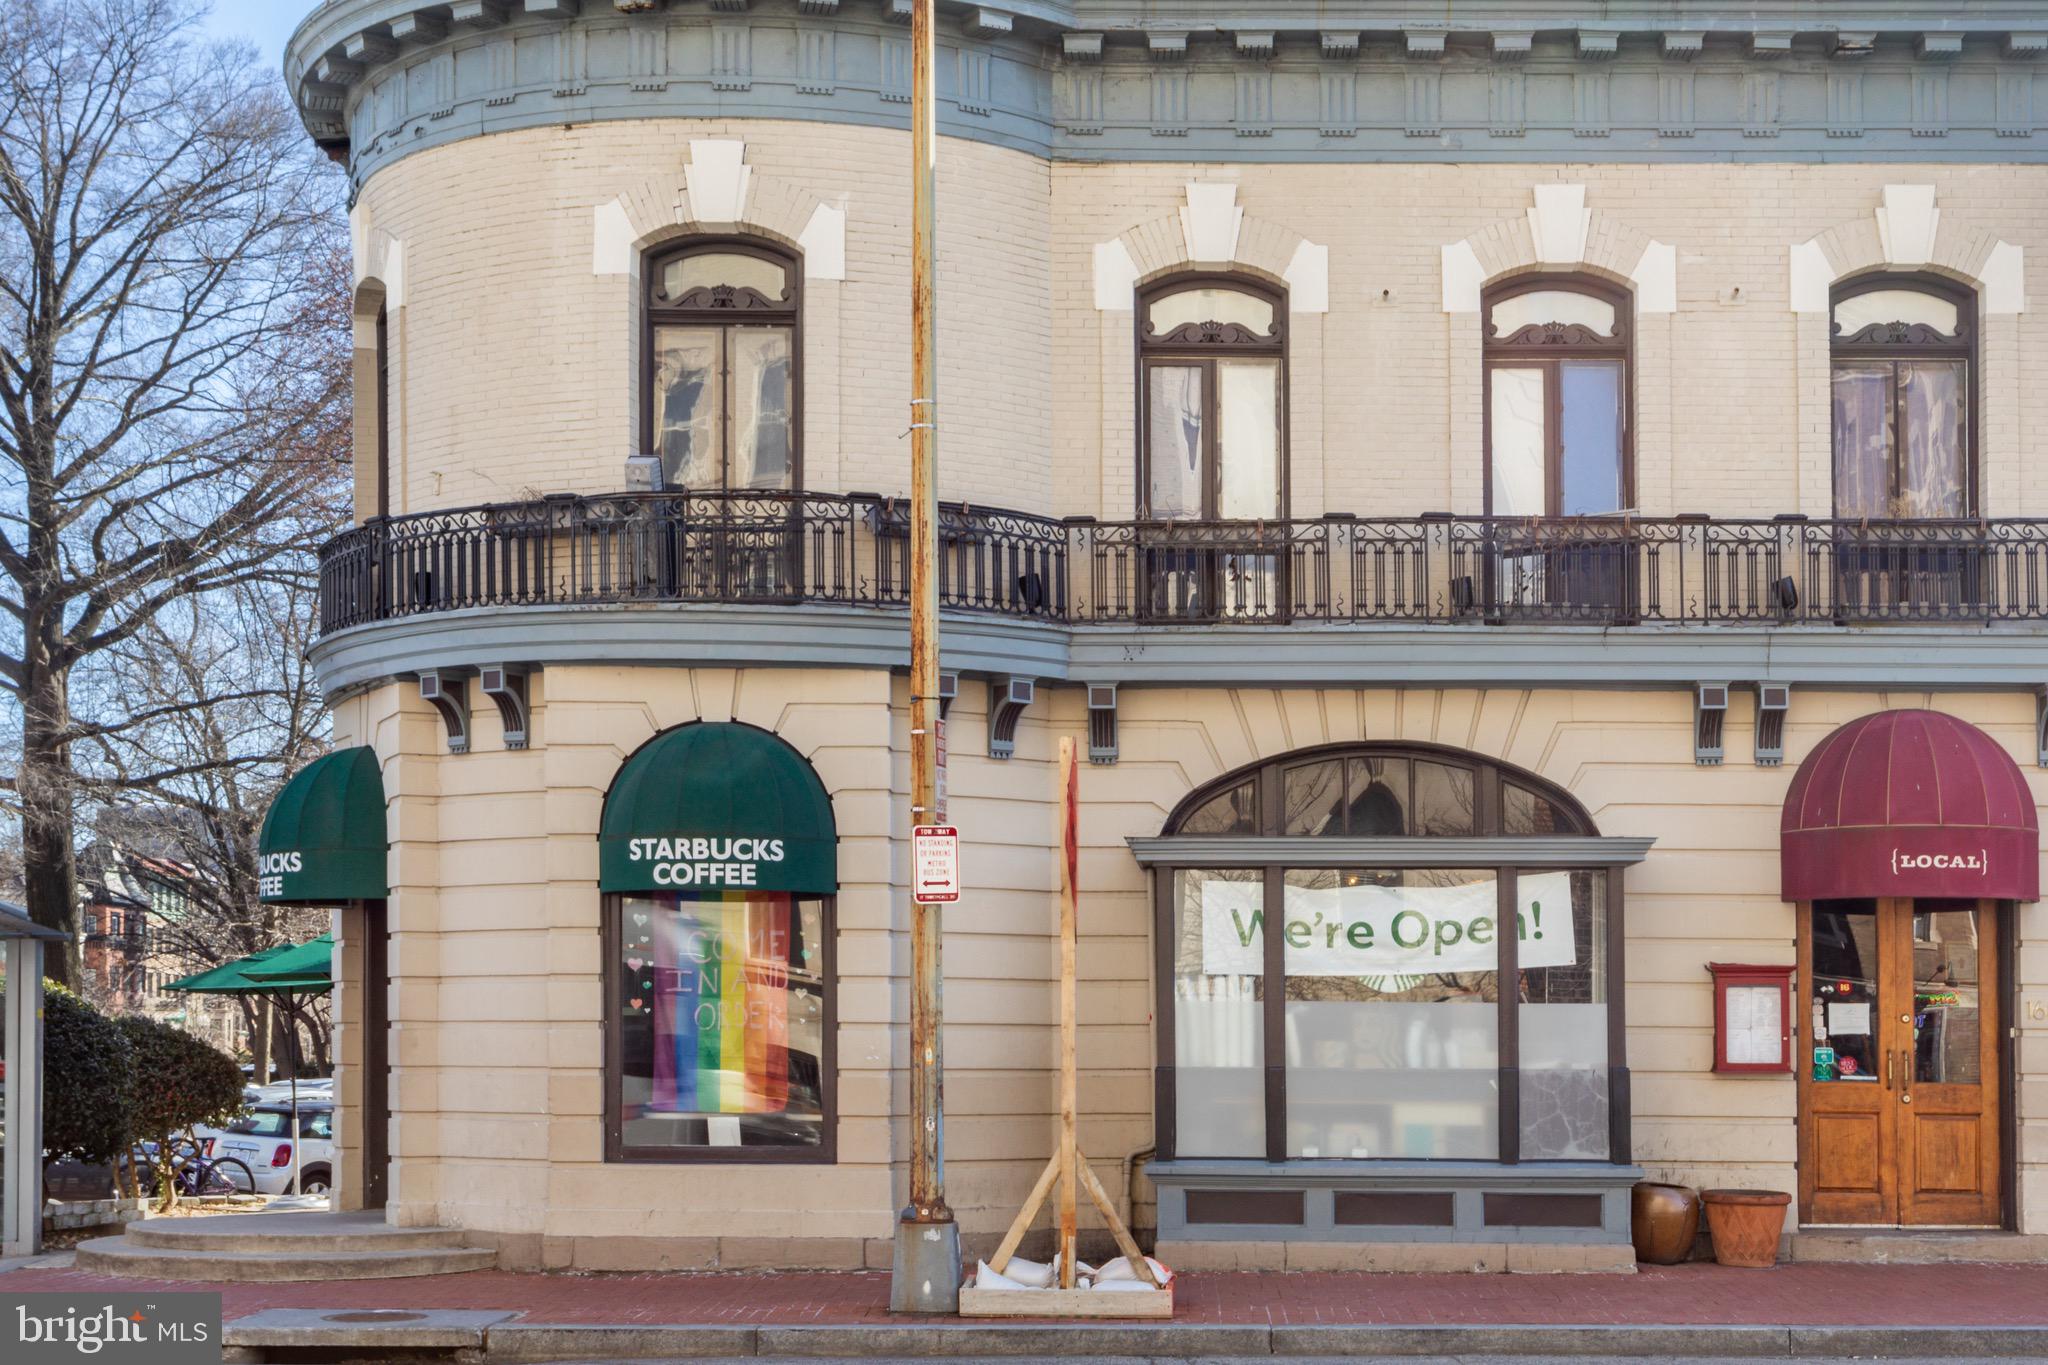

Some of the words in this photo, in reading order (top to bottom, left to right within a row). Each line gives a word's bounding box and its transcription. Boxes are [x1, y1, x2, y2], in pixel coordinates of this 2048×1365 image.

[920, 828, 932, 836] TOW
[629, 838, 785, 862] STARBUCKS
[653, 862, 758, 886] COFFEE
[1230, 908, 1375, 949] We're
[687, 928, 785, 964] COME
[665, 967, 719, 994] IN
[730, 962, 789, 994] AND
[694, 1000, 785, 1032] ORDER
[2027, 999, 2048, 1021] 16
